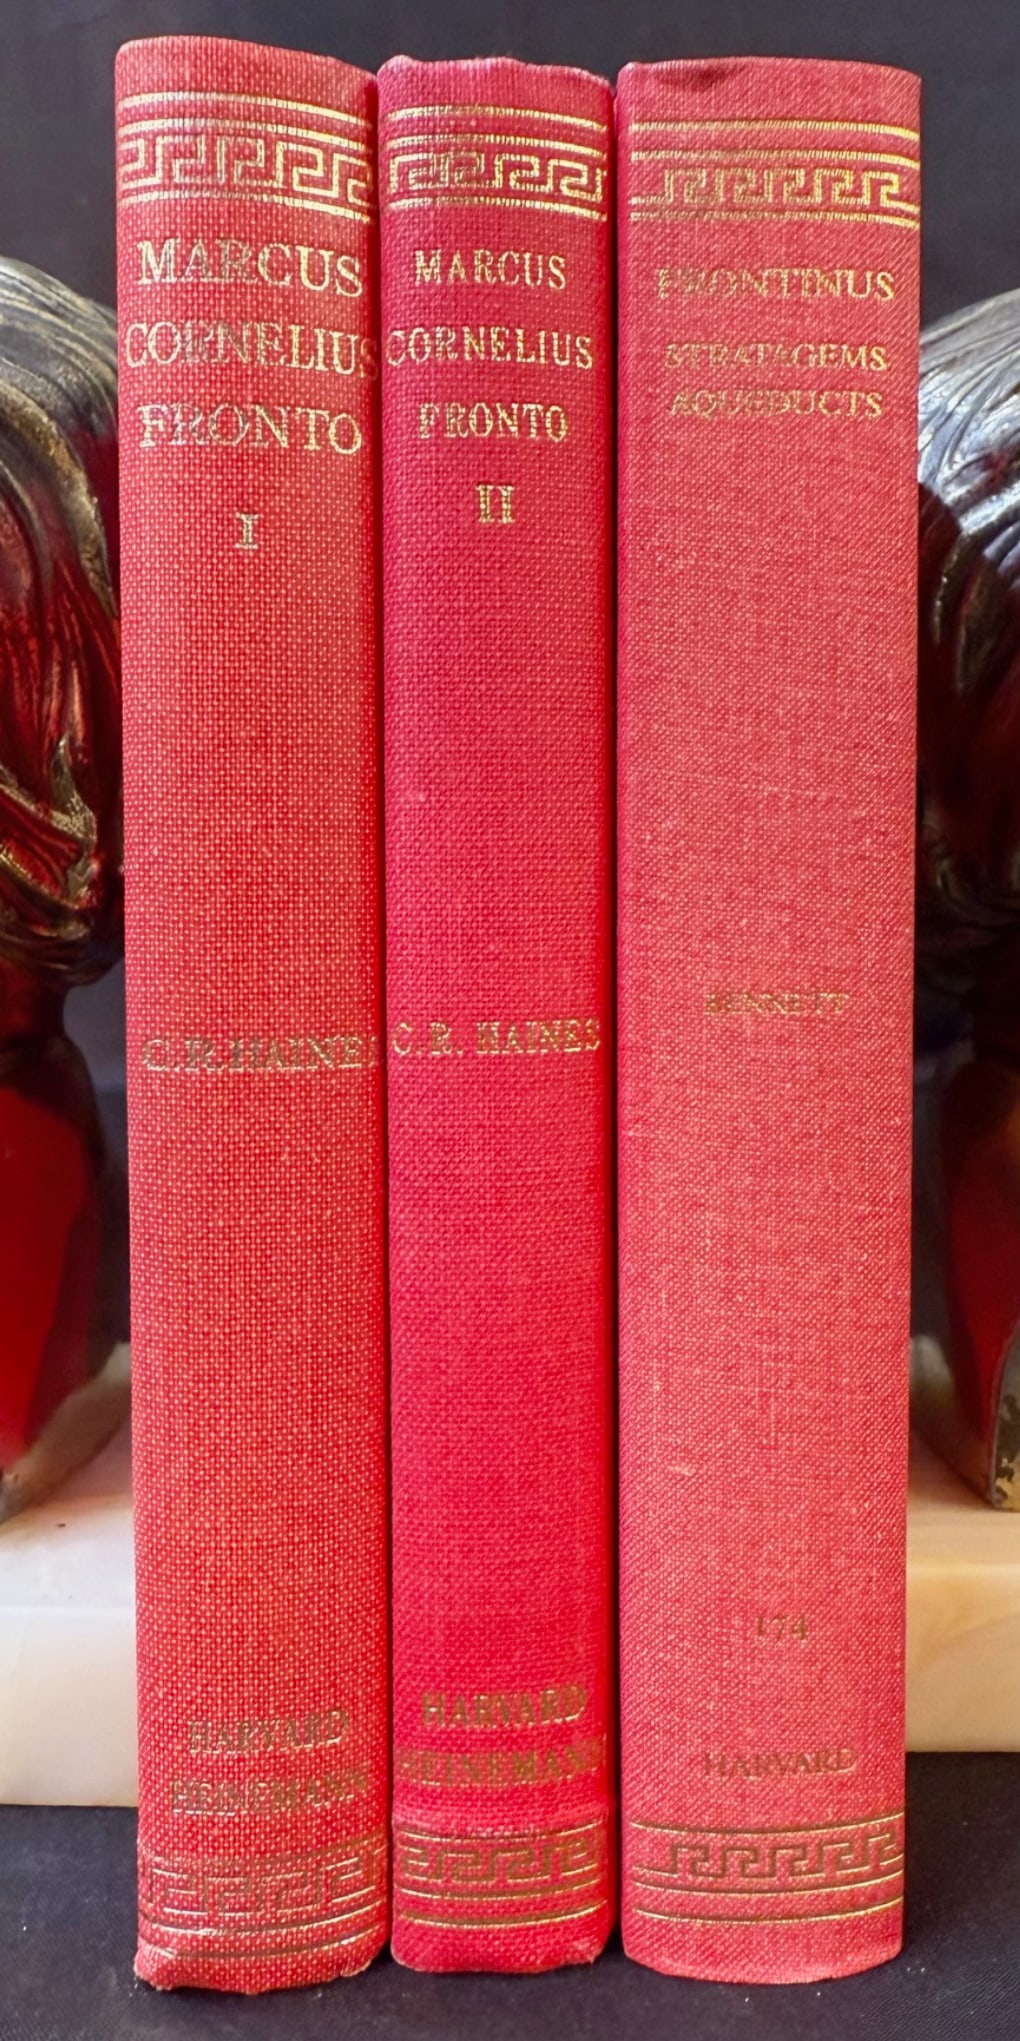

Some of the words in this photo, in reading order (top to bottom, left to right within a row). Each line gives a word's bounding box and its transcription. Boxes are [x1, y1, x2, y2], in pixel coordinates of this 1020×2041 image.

[137, 237, 363, 298] MARCUS
[414, 248, 566, 290] MARCUS
[124, 319, 379, 380] CORNELIUS
[386, 325, 593, 370] CORNELIUS
[137, 402, 363, 455] FRONTO
[418, 401, 570, 443] FRONTO
[475, 483, 516, 525] II
[234, 511, 260, 550] I
[475, 1018, 601, 1055] HAINES
[421, 1684, 589, 1731] HARVARD
[186, 1709, 349, 1756] HARVARD
